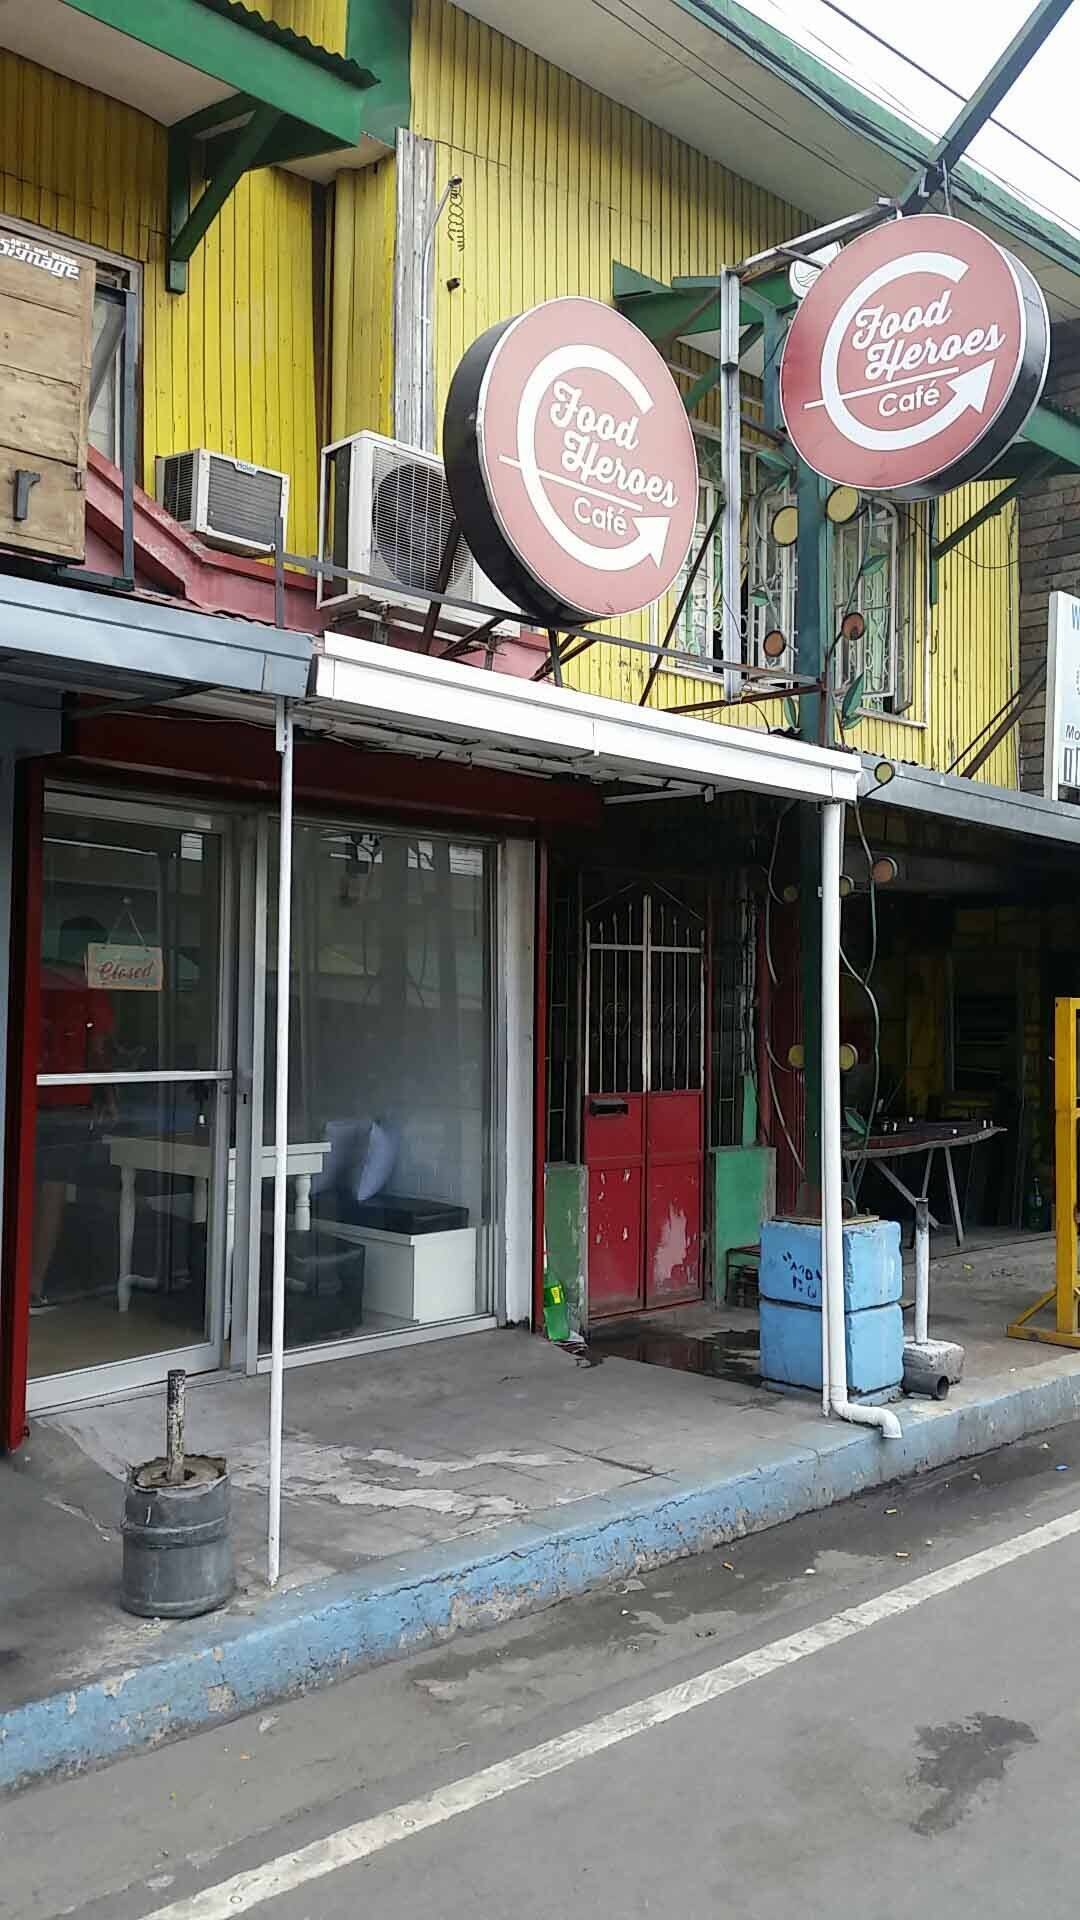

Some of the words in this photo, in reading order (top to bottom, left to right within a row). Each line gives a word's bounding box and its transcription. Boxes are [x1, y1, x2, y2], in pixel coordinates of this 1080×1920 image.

[852, 290, 952, 350] Food
[865, 324, 1006, 381] Heroes
[550, 380, 639, 450] Food
[879, 381, 940, 417] Café
[561, 430, 679, 508] Heroes
[573, 496, 629, 535] Café
[97, 959, 154, 980] Closed
